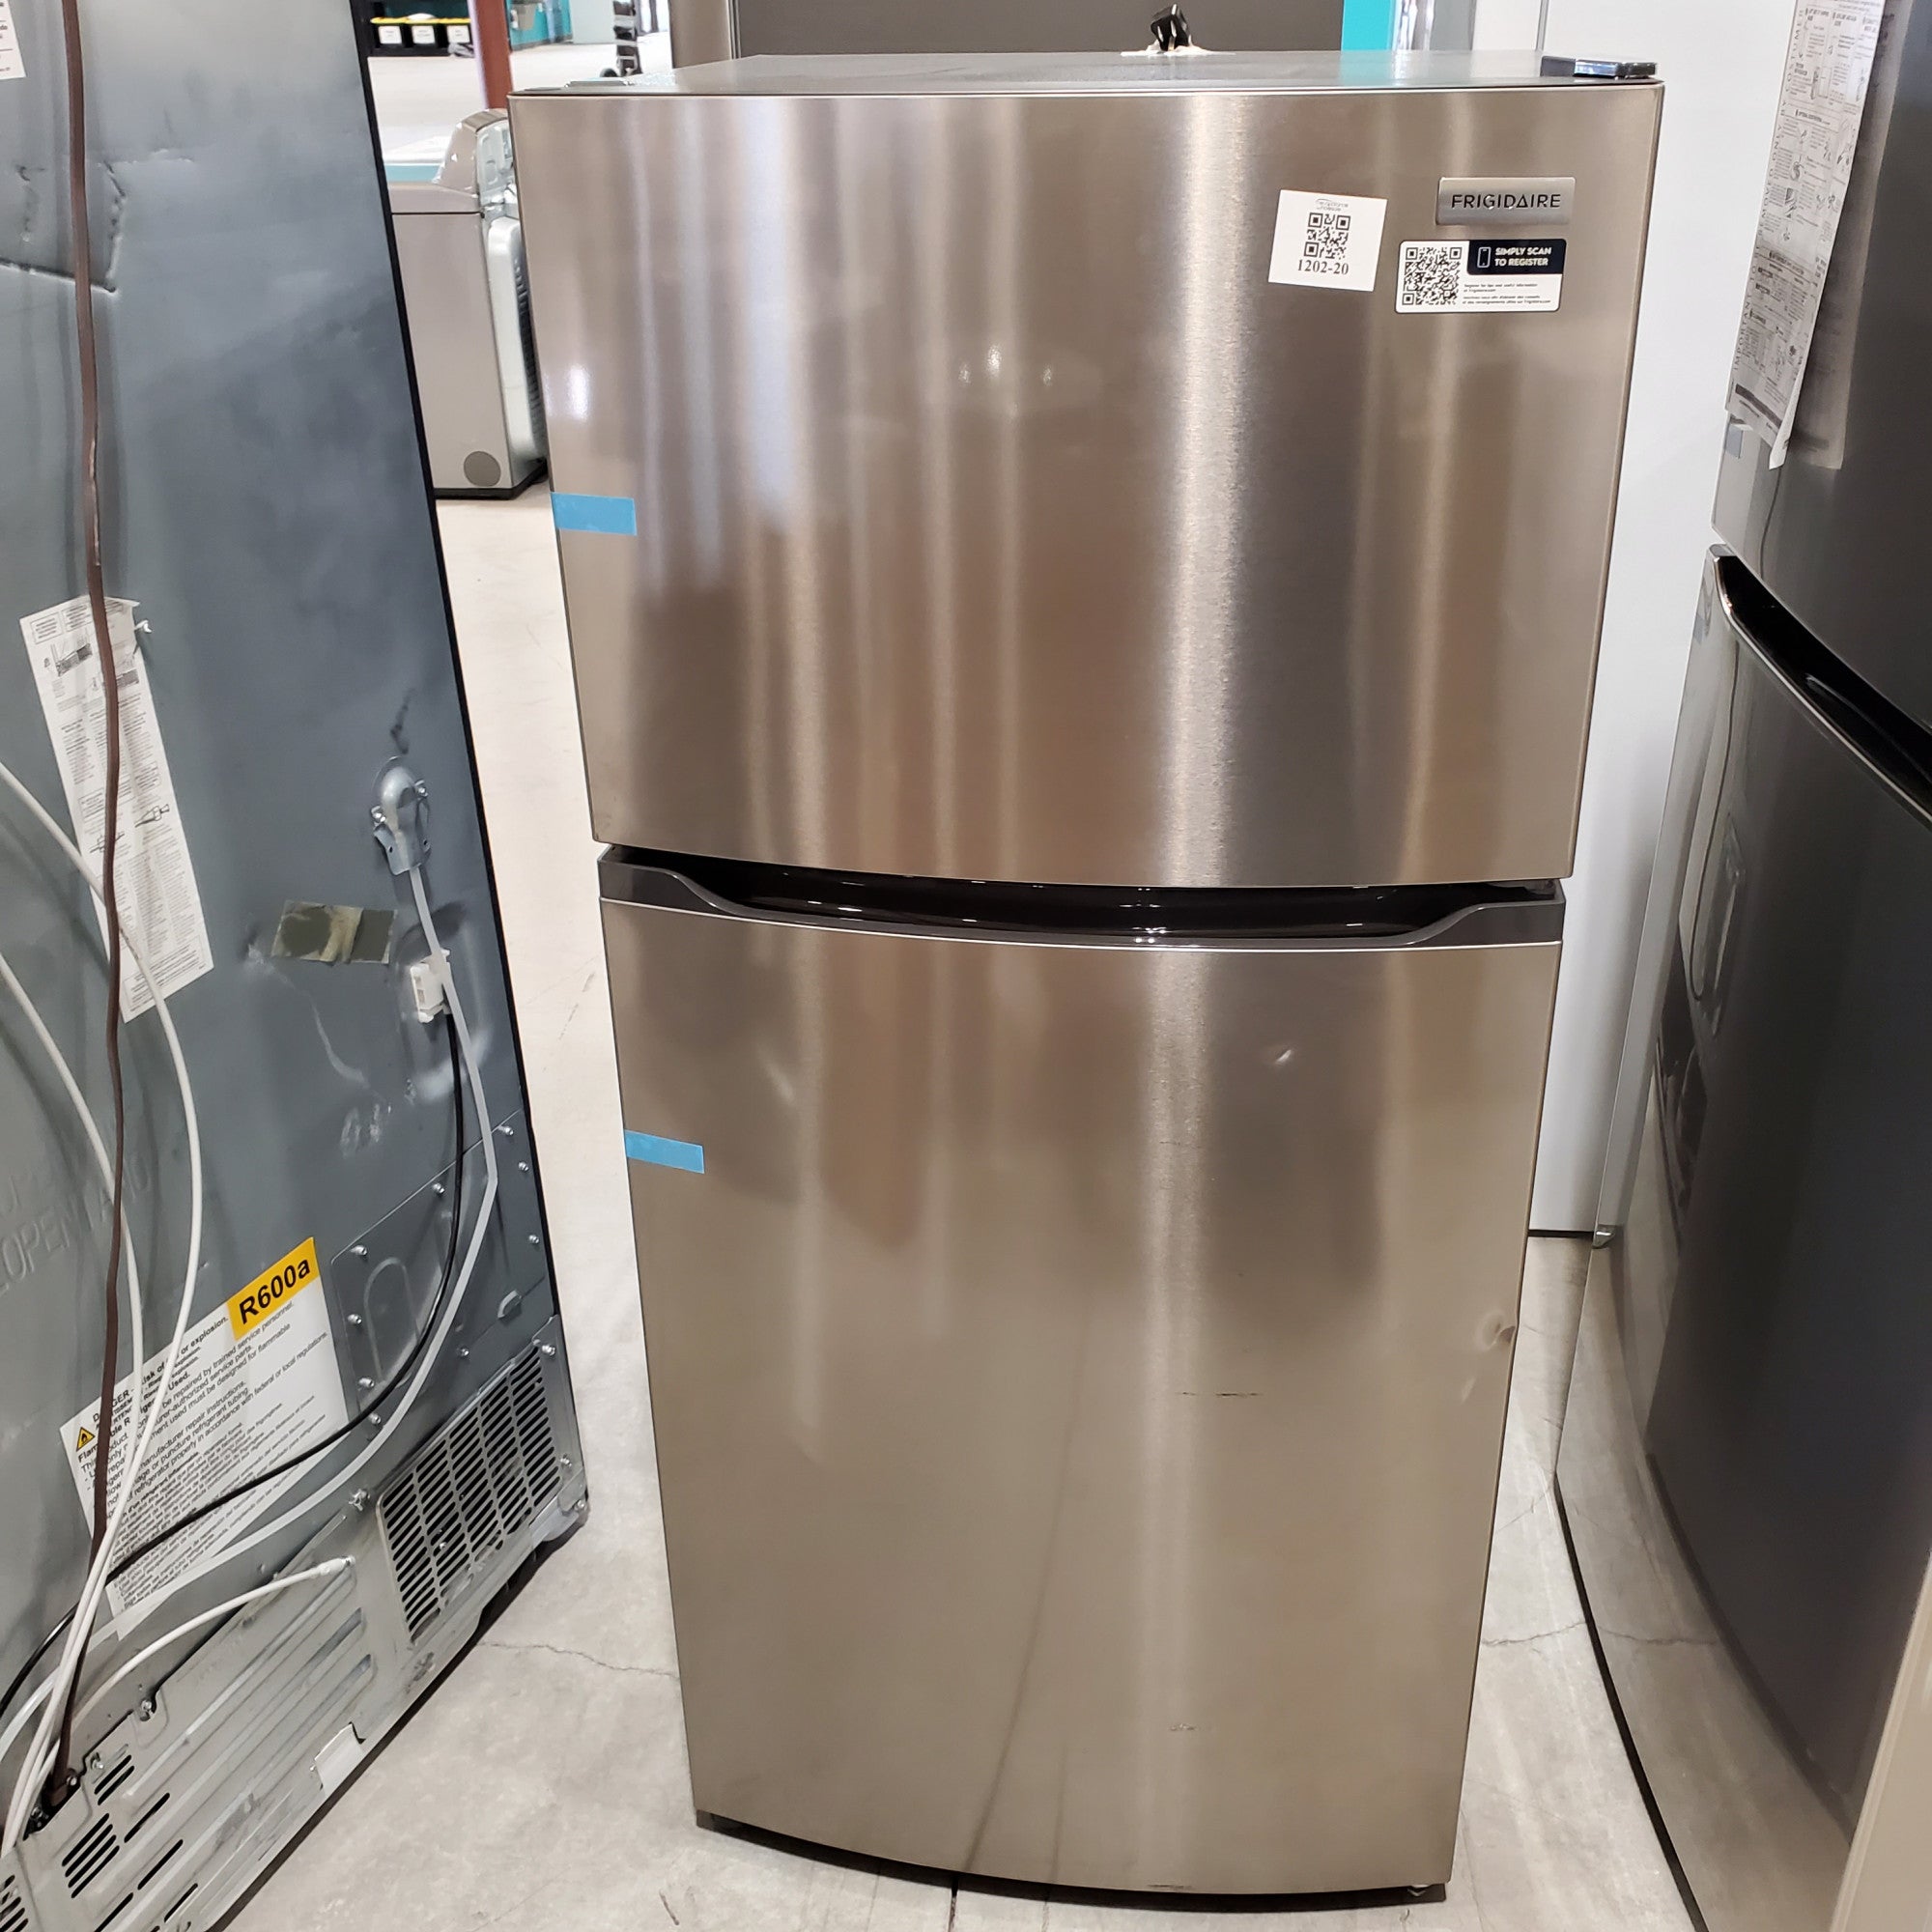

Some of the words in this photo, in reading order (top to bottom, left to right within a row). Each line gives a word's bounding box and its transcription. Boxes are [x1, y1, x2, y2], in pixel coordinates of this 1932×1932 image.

[1452, 194, 1561, 209] FRIGIDAIRE
[1527, 246, 1552, 255] SCAN
[1298, 259, 1350, 274] 1202-20
[239, 1260, 310, 1324] R600a
[156, 1361, 165, 1374] of
[180, 1343, 189, 1355] or
[161, 1396, 172, 1409] be
[172, 1372, 203, 1402] repaired
[202, 1364, 213, 1378] by
[212, 1345, 237, 1369] trained
[236, 1326, 261, 1350] service
[209, 1357, 235, 1382] service
[167, 1369, 190, 1392] Used.
[168, 1405, 187, 1425] used
[186, 1390, 206, 1409] must
[205, 1381, 216, 1395] be
[215, 1357, 247, 1388] designed
[246, 1349, 258, 1361] for
[256, 1321, 291, 1353] flammable
[133, 1461, 171, 1497] refrigerator
[169, 1437, 198, 1467] properly
[196, 1433, 204, 1443] in
[204, 1402, 241, 1436] accordance
[240, 1391, 254, 1406] with
[253, 1373, 275, 1396] federal
[274, 1368, 282, 1378] or
[280, 1354, 297, 1372] local
[185, 1411, 206, 1434] repair
[150, 1459, 160, 1471] or
[159, 1433, 192, 1464] puncture
[191, 1403, 227, 1438] refrigerant
